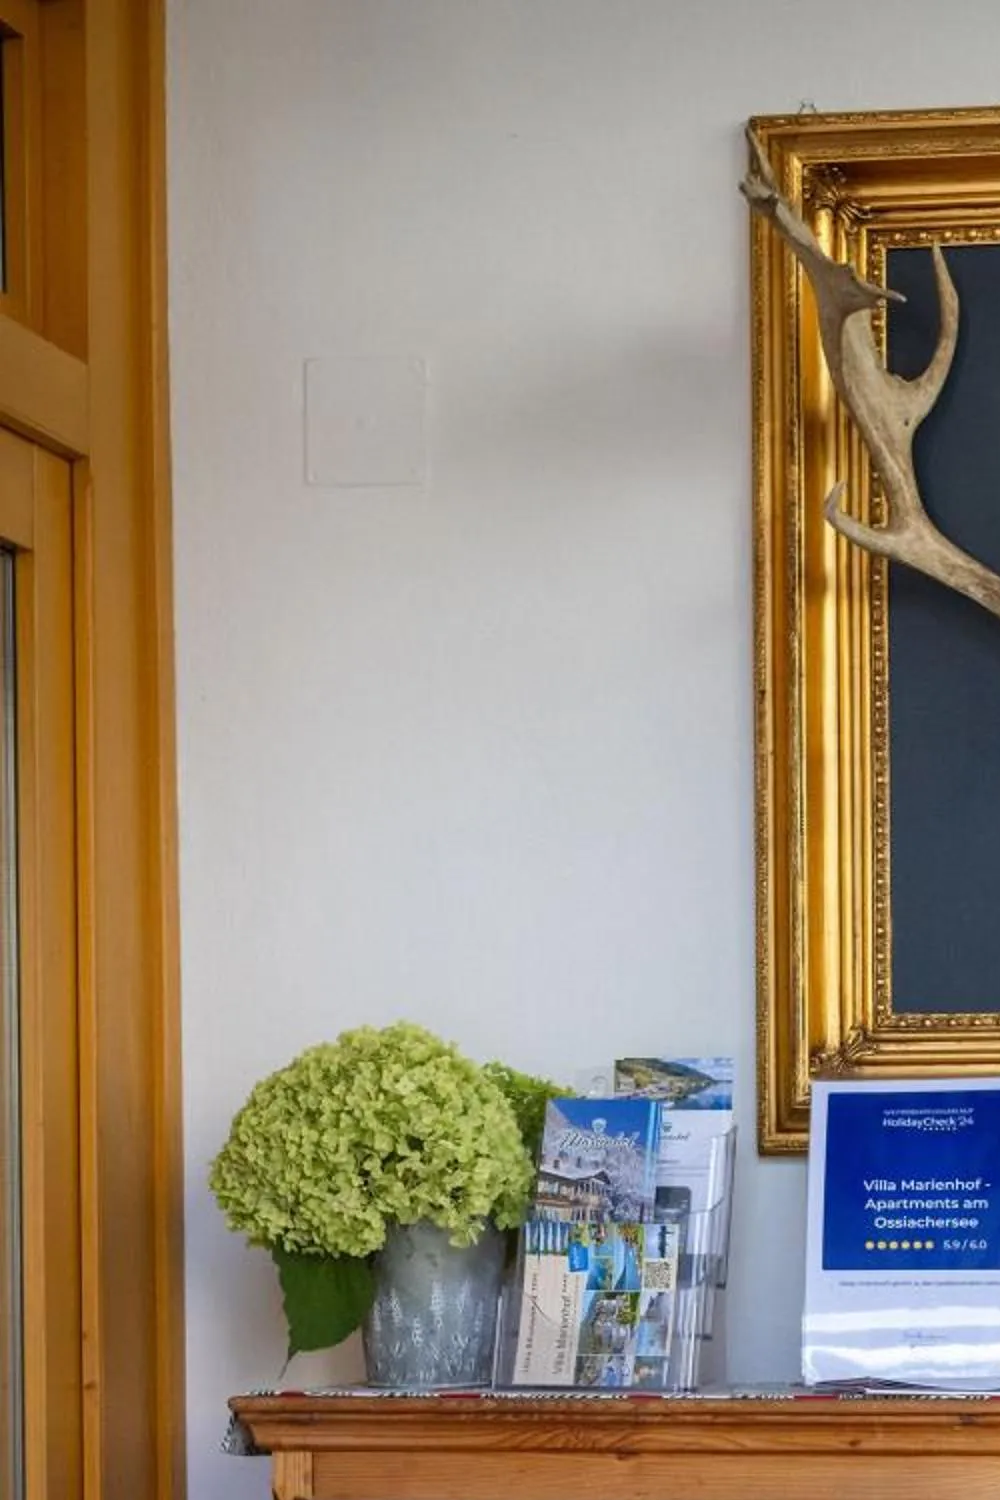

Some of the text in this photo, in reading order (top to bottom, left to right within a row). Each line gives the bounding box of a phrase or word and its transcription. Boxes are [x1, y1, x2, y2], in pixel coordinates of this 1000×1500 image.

[863, 1179, 897, 1192] Villa
[901, 1178, 982, 1192] Marienhof
[863, 1198, 989, 1213] Apartments am
[873, 1215, 980, 1229] Ossiachersee
